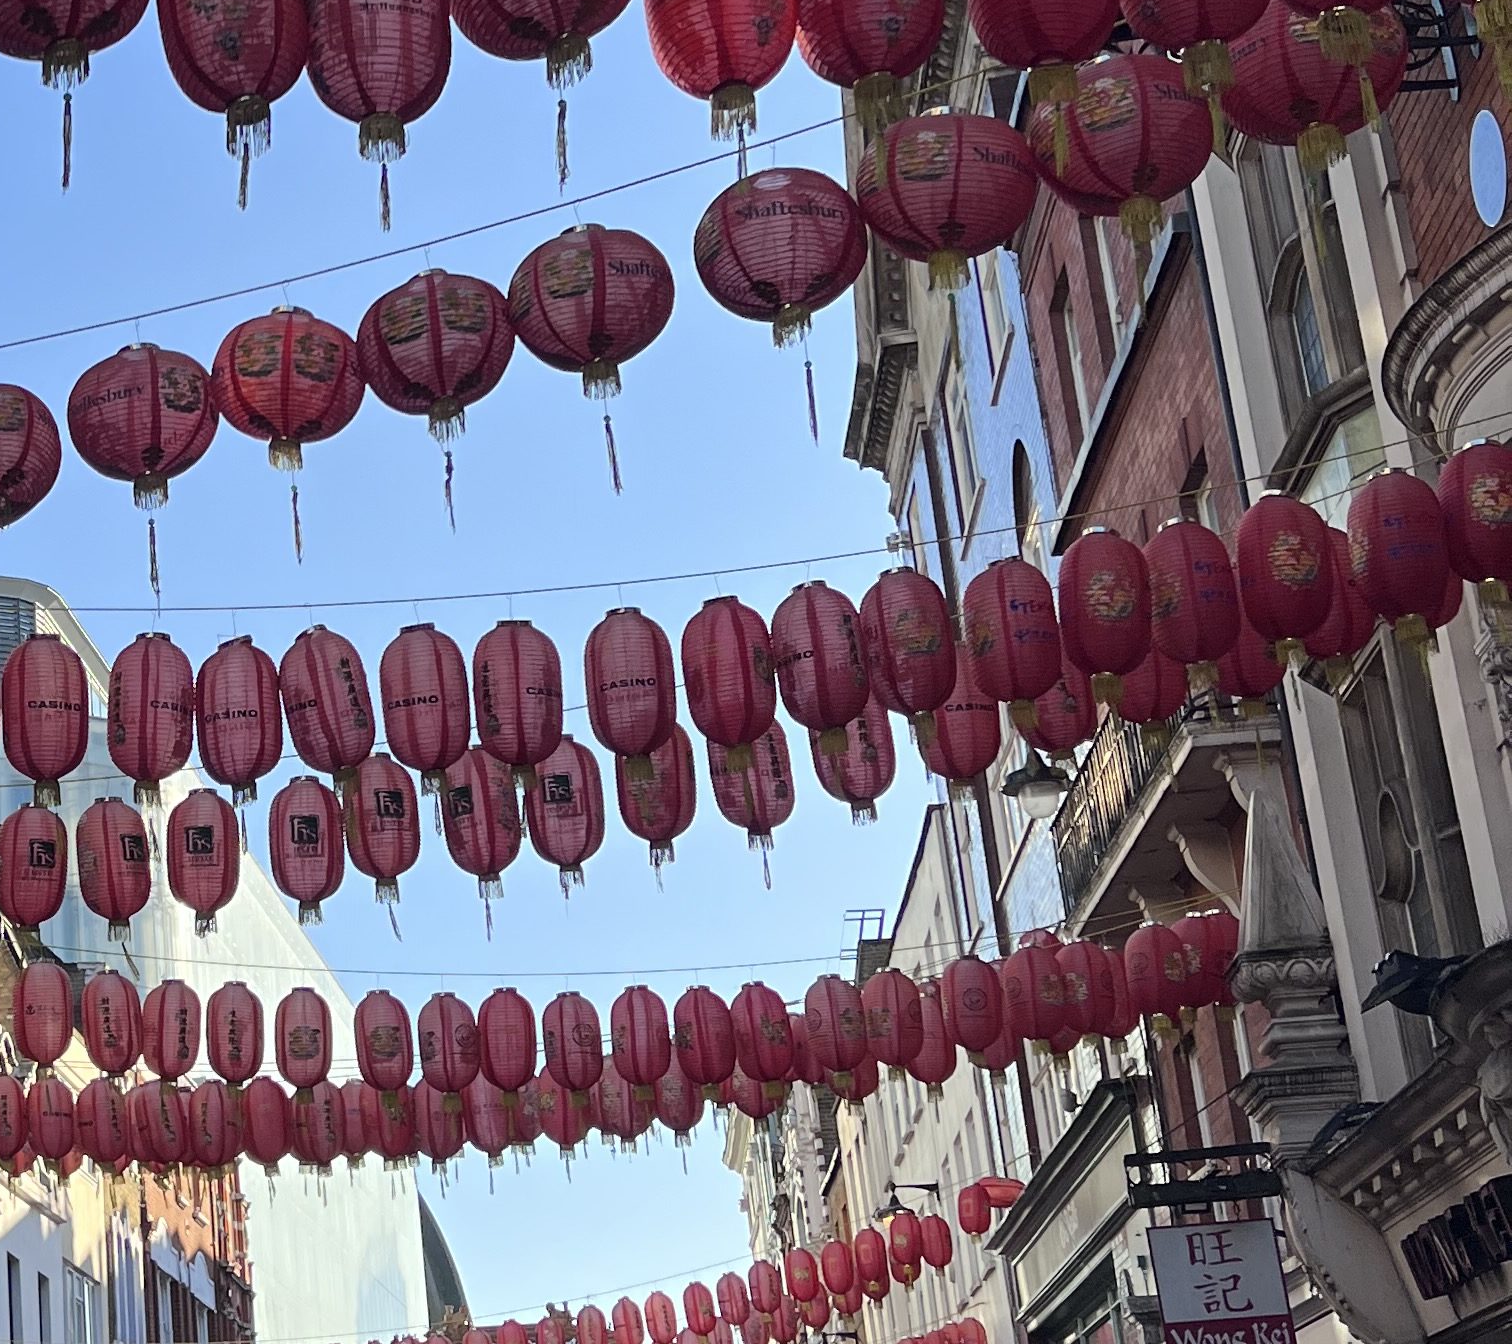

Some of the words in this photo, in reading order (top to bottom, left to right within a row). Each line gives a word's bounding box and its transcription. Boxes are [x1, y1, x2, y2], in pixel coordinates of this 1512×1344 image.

[599, 676, 657, 692] CASINO
[27, 699, 81, 712] CASINO
[386, 694, 439, 710] CASINO
[204, 708, 258, 724] CASINO
[1185, 1228, 1255, 1315] 旺記
